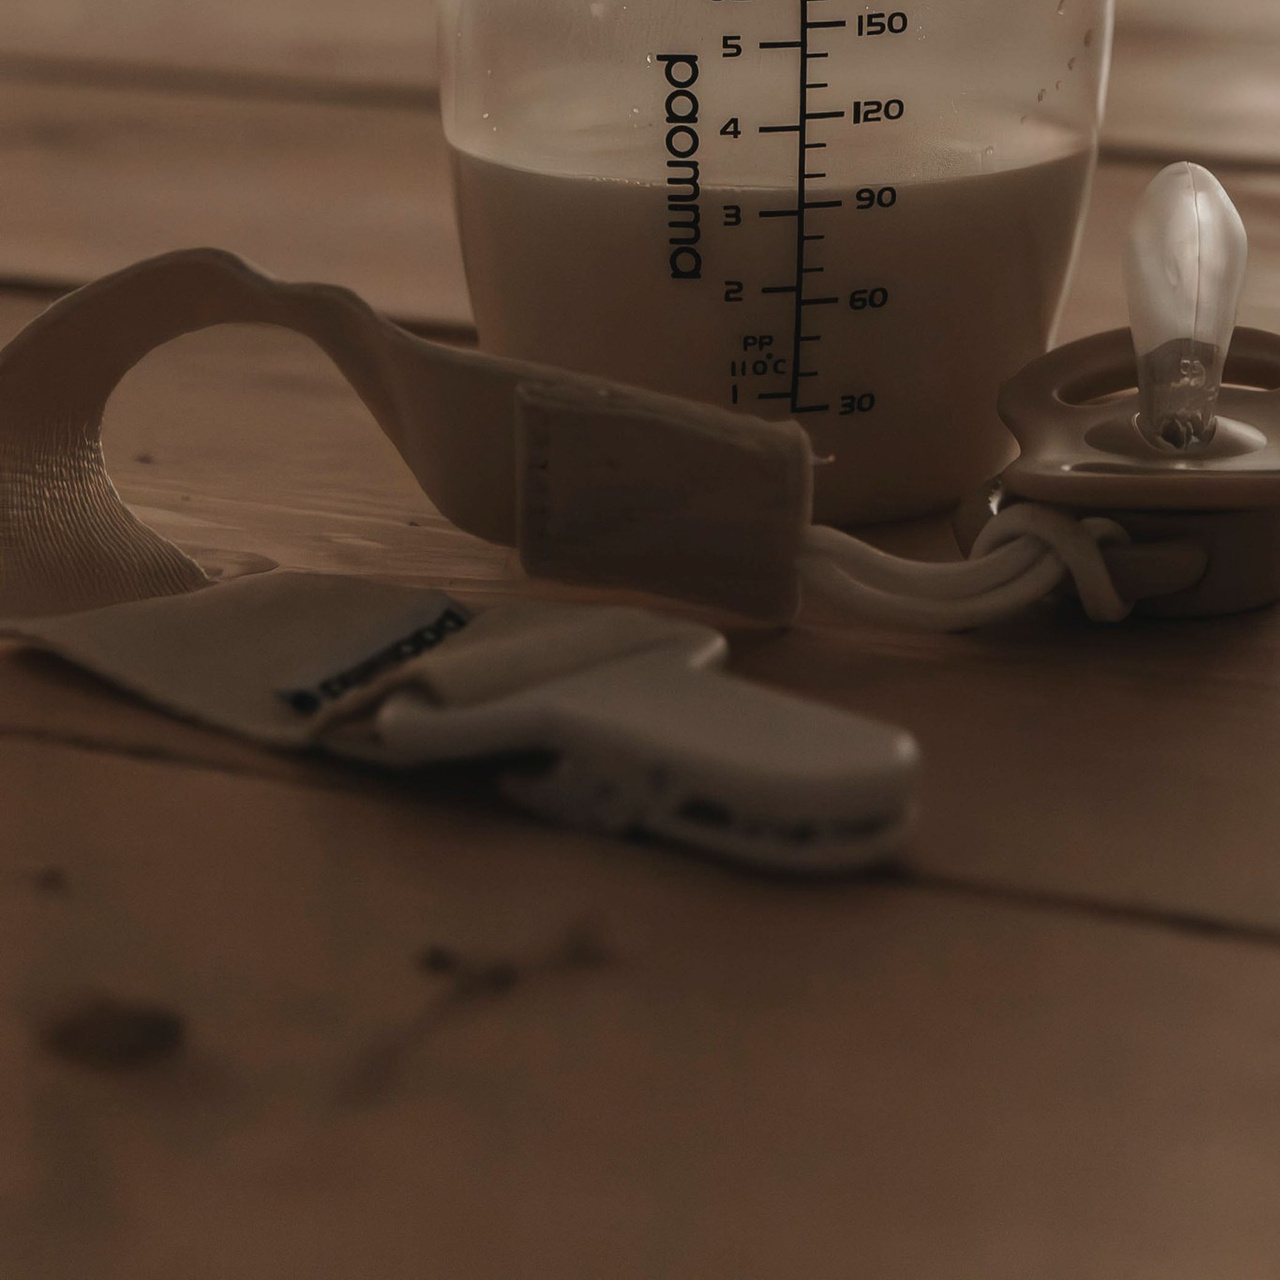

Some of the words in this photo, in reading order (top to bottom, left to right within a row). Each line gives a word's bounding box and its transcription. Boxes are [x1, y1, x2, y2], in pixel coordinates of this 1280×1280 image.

[857, 12, 908, 36] 150
[722, 35, 742, 58] 5
[853, 99, 904, 124] 120
[720, 118, 741, 139] 4
[656, 54, 702, 279] paomma
[856, 187, 896, 209] 90
[723, 205, 742, 226] 3
[724, 280, 743, 302] 2
[849, 287, 888, 310] 60
[839, 393, 875, 415] 30
